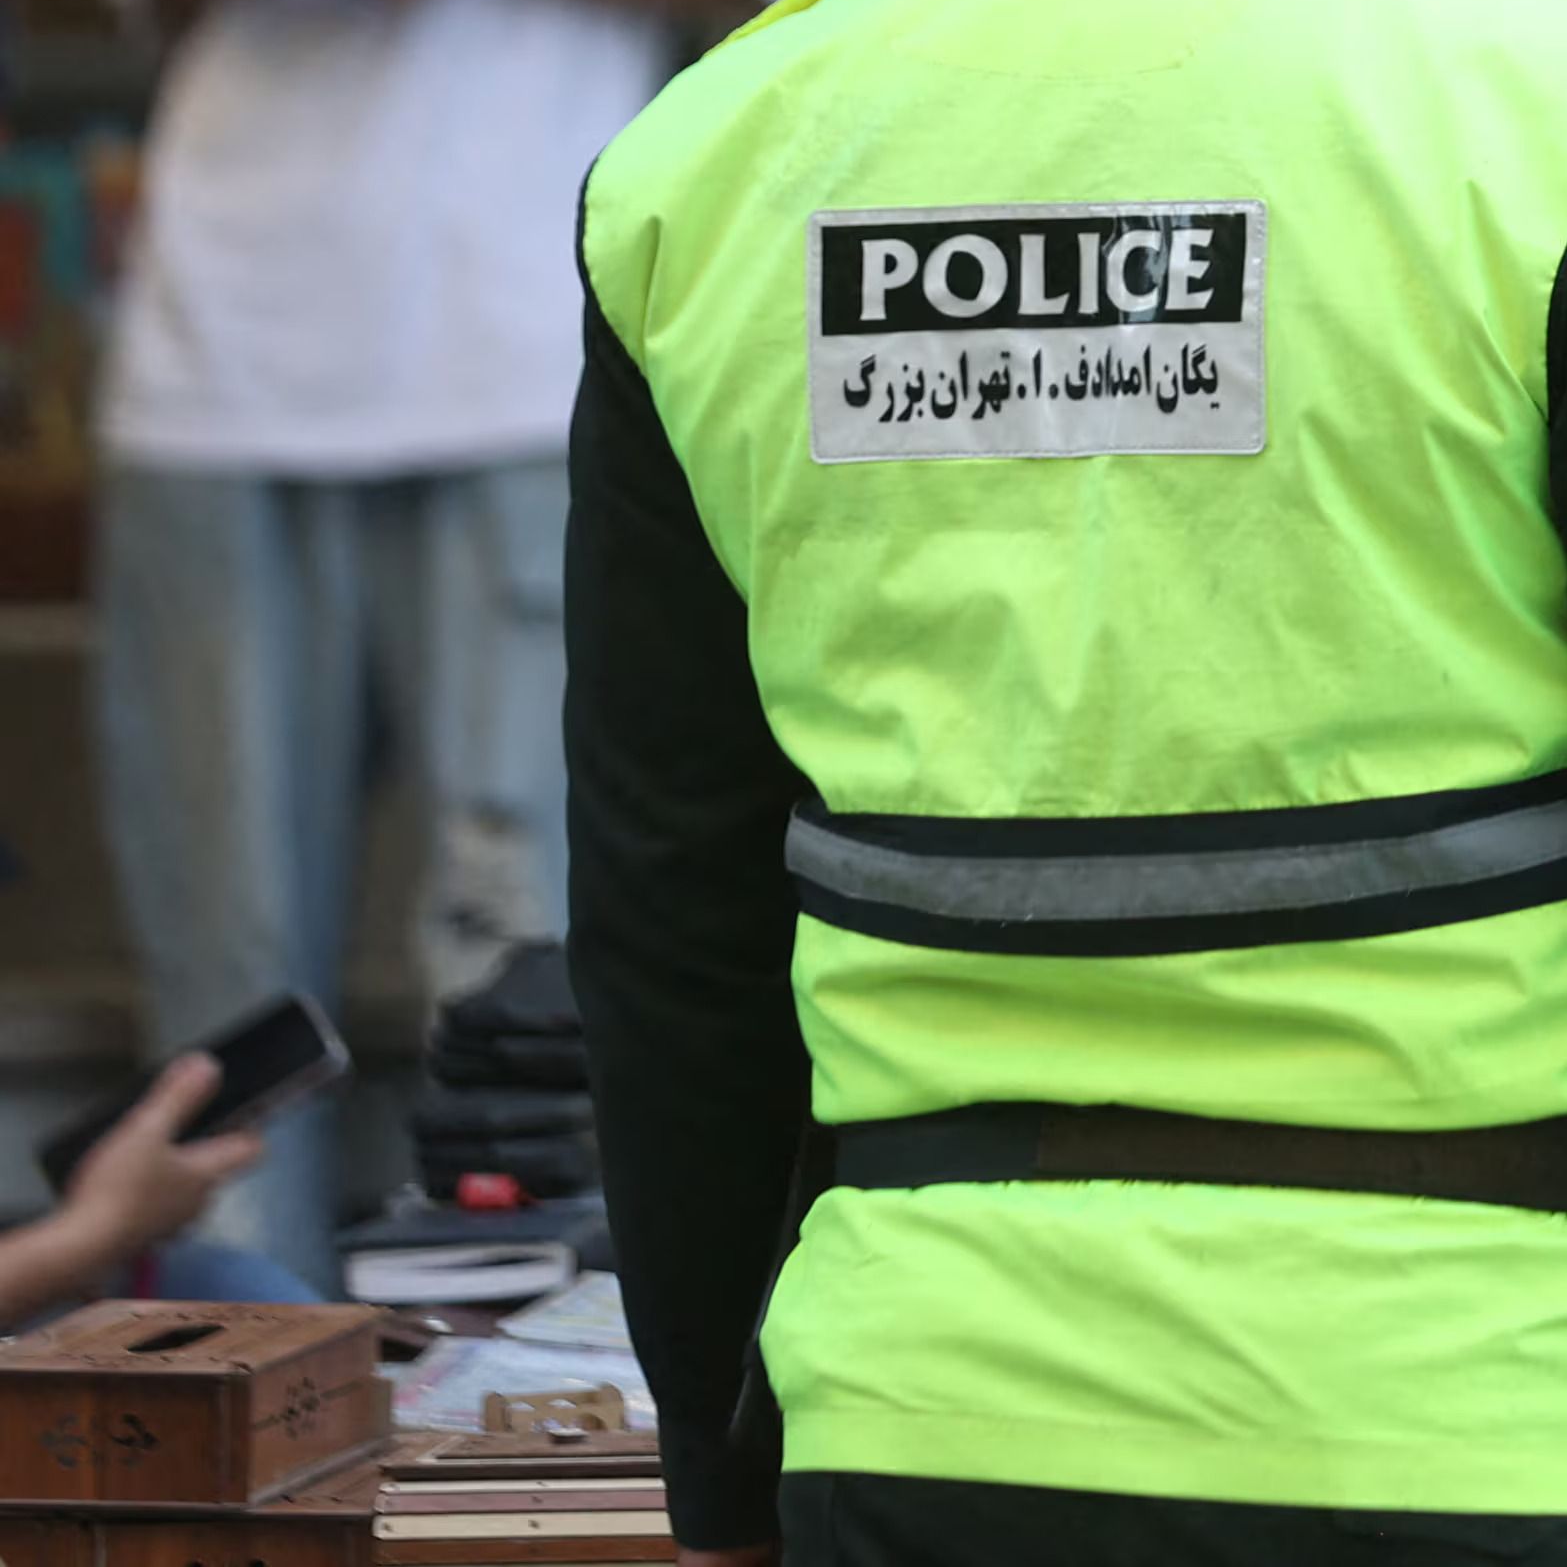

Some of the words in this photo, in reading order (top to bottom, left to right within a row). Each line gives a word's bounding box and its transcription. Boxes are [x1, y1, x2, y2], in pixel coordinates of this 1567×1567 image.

[860, 229, 1215, 321] POLICE
[843, 354, 925, 423] بزرگ
[930, 350, 1011, 420] تهران
[1156, 344, 1220, 414] یگان
